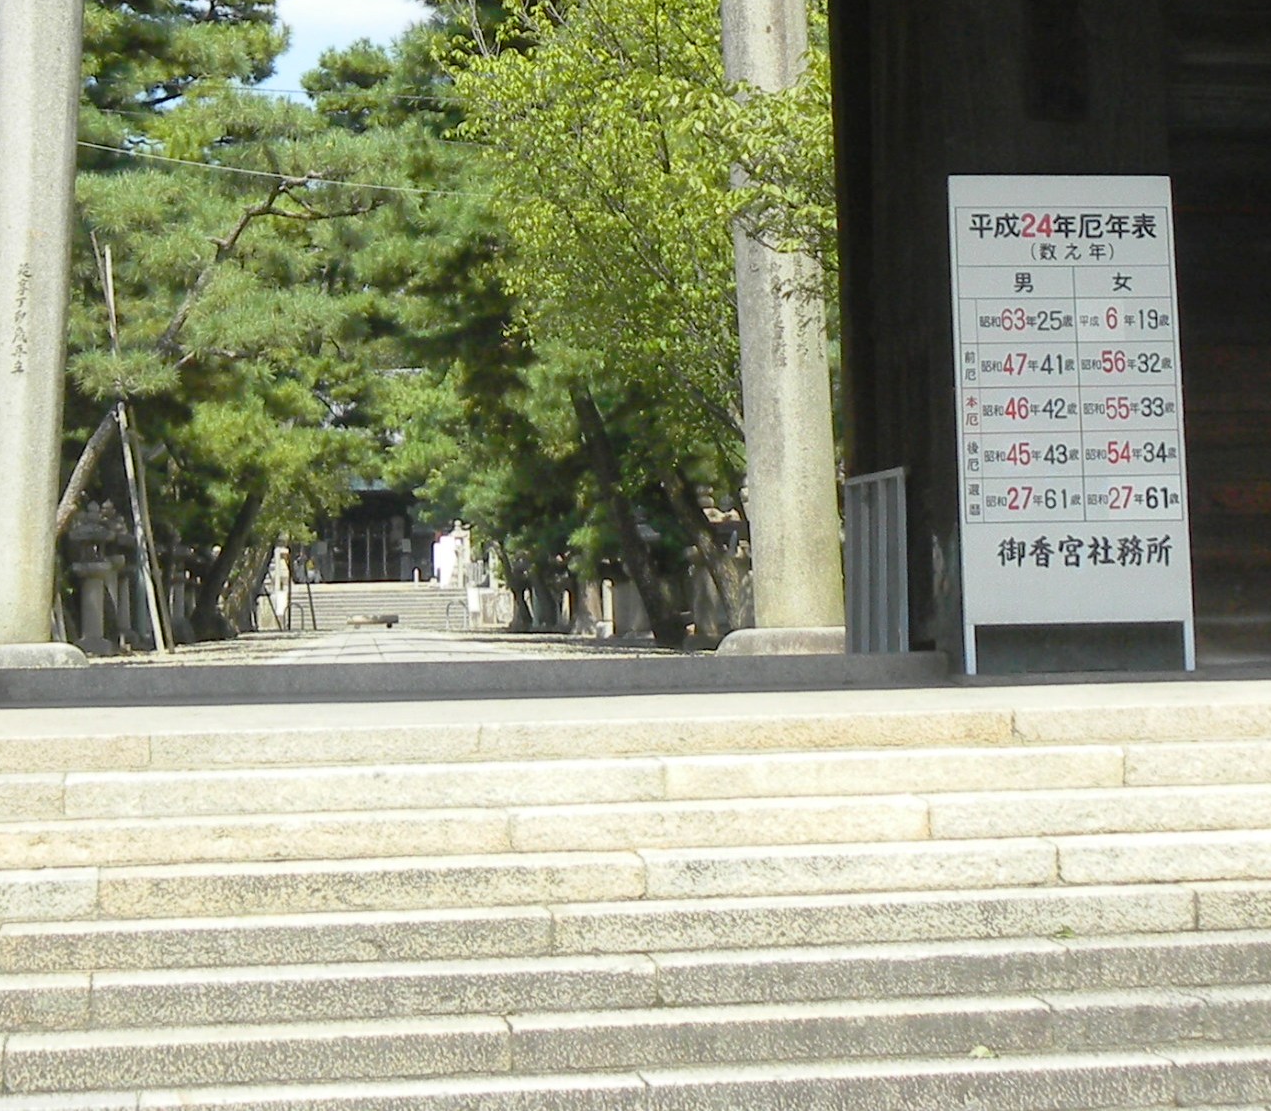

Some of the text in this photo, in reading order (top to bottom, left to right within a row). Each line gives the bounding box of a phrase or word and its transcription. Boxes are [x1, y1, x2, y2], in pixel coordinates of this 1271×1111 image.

[969, 213, 1157, 238] 平成24年厄年表
[1014, 272, 1034, 293] 男
[1112, 272, 1132, 291] 女
[964, 351, 977, 381] 前厄
[965, 396, 979, 426] 本厄
[967, 441, 980, 471] 後厄
[997, 534, 1173, 568] 御香宮社務所
